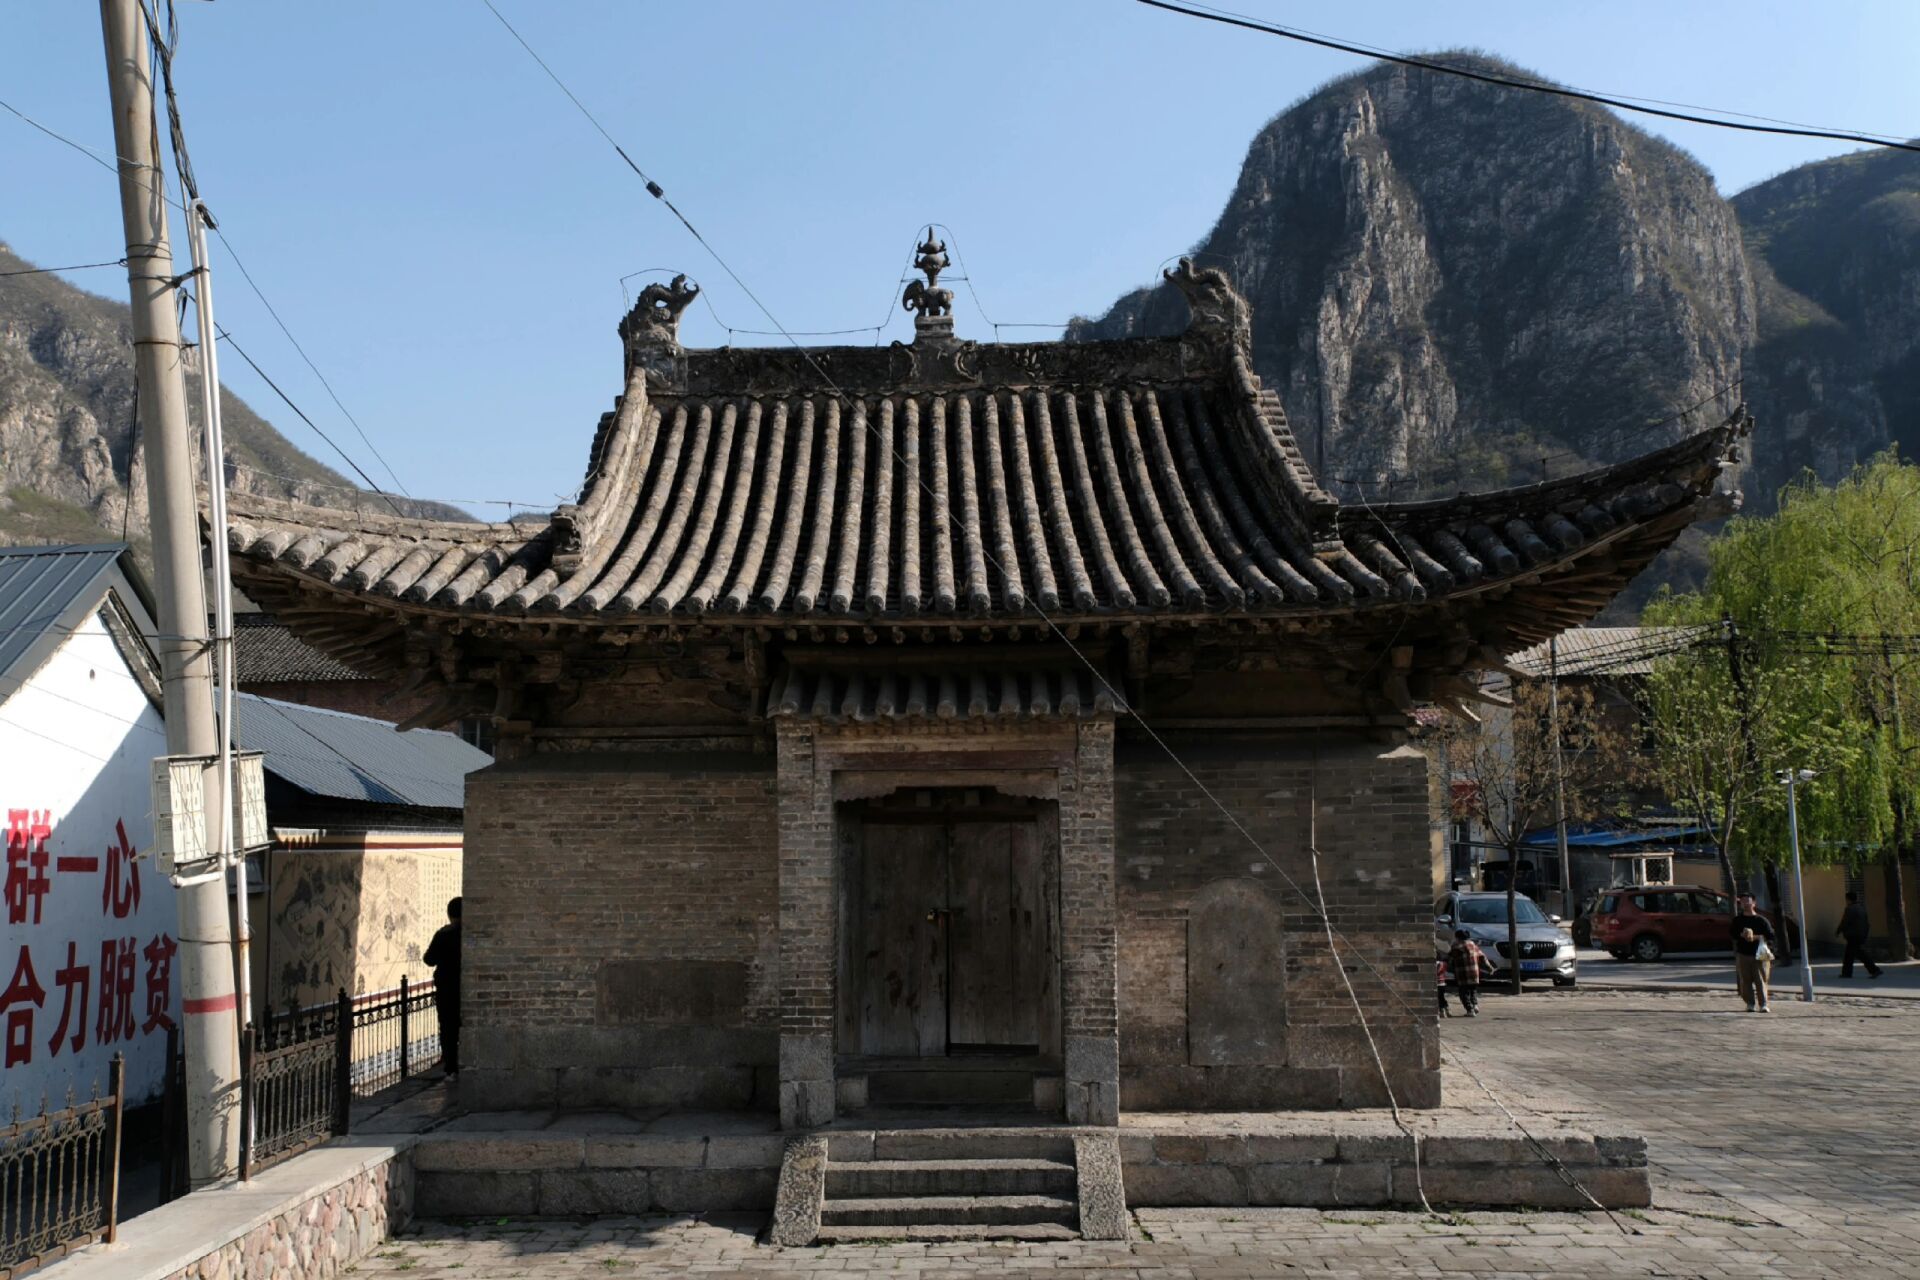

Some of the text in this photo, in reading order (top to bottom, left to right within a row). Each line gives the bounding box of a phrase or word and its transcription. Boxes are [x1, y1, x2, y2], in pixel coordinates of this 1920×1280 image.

[4, 808, 141, 925] 群一心
[0, 932, 177, 1069] 合力脱贫
